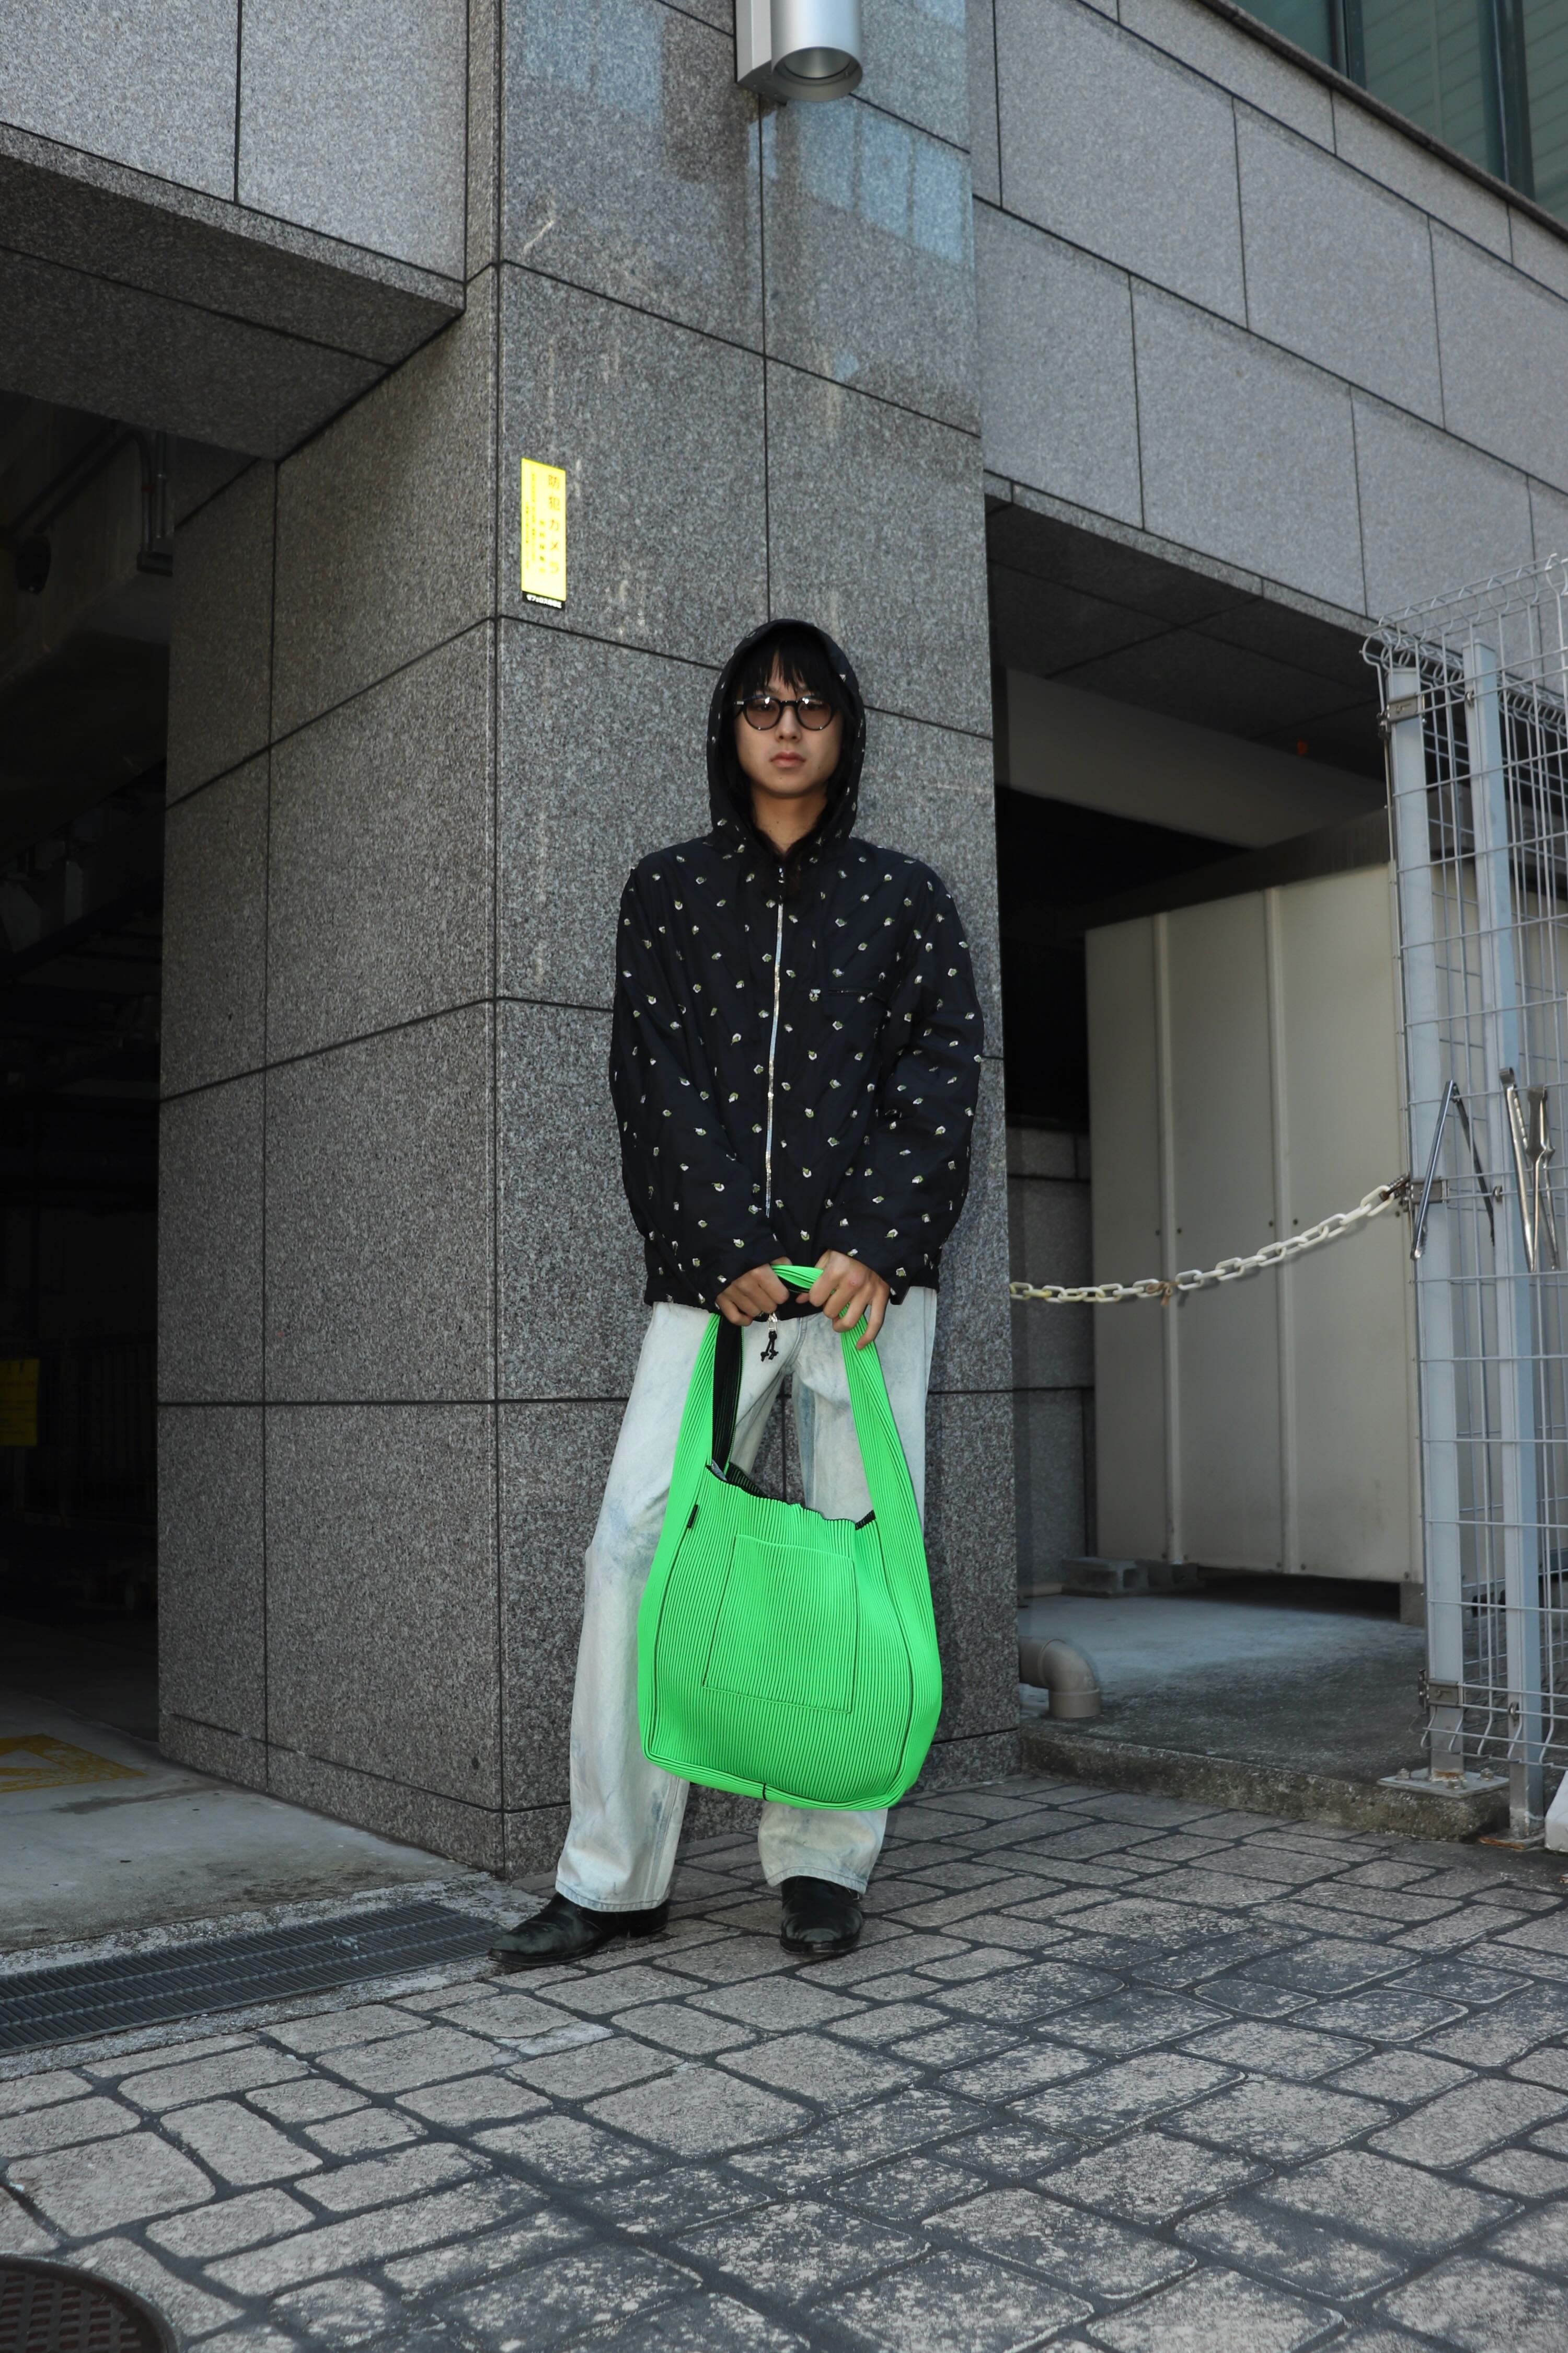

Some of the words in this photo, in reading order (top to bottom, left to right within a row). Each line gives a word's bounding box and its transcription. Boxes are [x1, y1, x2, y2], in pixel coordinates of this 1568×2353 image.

[548, 474, 560, 574] 防犯カメラ
